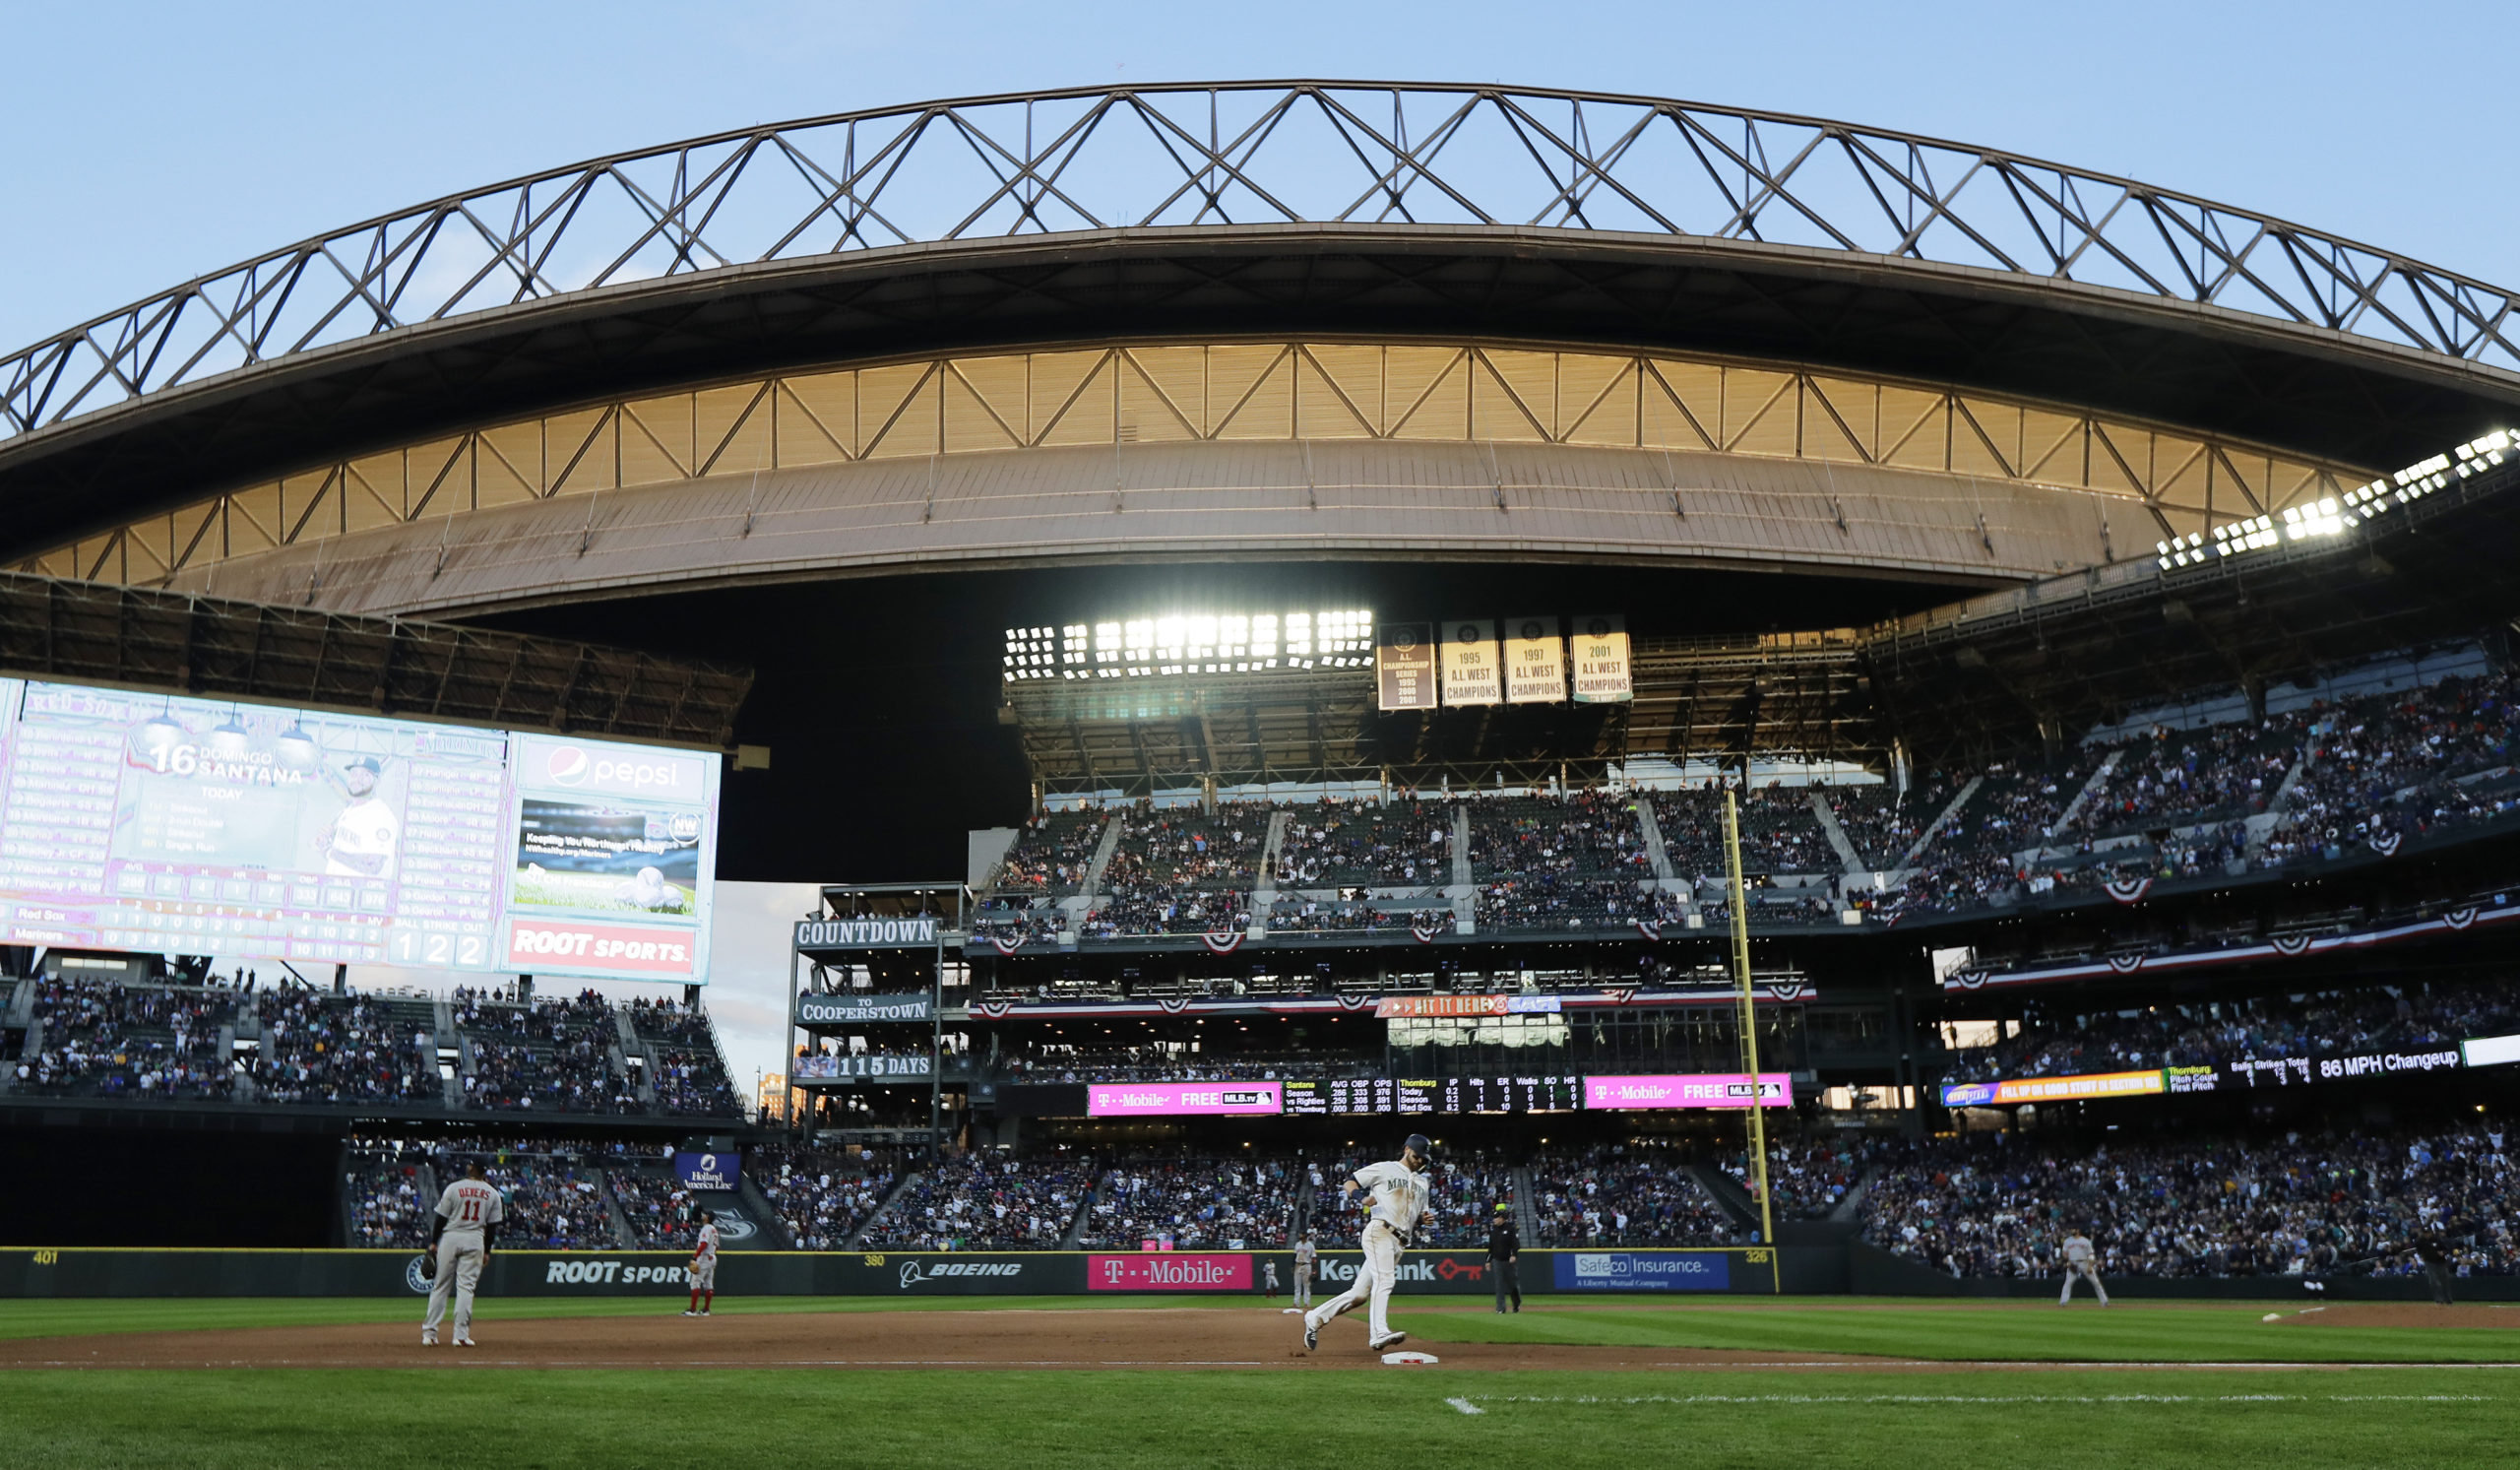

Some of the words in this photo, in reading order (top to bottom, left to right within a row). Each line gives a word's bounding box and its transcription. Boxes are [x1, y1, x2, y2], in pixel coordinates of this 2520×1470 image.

[1459, 652, 1480, 664] 1995
[1524, 649, 1544, 661] 1997
[1590, 646, 1610, 658] 2001
[1383, 661, 1429, 671] CHAMPIONSHIP
[1516, 667, 1531, 678] A.L.
[1532, 665, 1554, 677] WEST
[1583, 663, 1597, 674] A.L.
[1599, 662, 1621, 673] WEST
[1395, 670, 1418, 678] SERIES
[1451, 670, 1466, 681] A.L.
[1468, 668, 1490, 680] WEST
[1447, 685, 1497, 699] CHAMPIONS
[1511, 682, 1561, 696] CHAMPIONS
[1578, 678, 1627, 692] CHAMPIONS
[150, 743, 196, 775] 16
[201, 747, 272, 764] DOMINGO
[199, 761, 302, 784] SANTANA
[595, 760, 677, 789] pepsi
[202, 786, 244, 800] TODAY
[674, 818, 697, 832] NW
[526, 833, 564, 847] Keeping
[564, 836, 583, 847] You
[583, 837, 631, 853] Northwest
[631, 840, 665, 856] Healthy
[525, 844, 612, 860] NWhealthy.org/Mariners
[18, 907, 42, 920] Red
[44, 909, 67, 923] Sox
[324, 927, 337, 938] 10
[368, 917, 383, 927] MV
[394, 917, 419, 930] BALL
[423, 920, 459, 933] STRIKE
[463, 922, 485, 934] OUT
[797, 920, 935, 944] COUNTDOWN
[15, 927, 64, 942] Mariners
[297, 944, 311, 956] 10
[322, 945, 333, 957] 11
[398, 933, 411, 961] 1
[426, 934, 449, 963] 2
[460, 936, 481, 965] 2
[514, 928, 594, 956] ROOT
[594, 938, 687, 963] SPORTS
[857, 998, 873, 1007] TO
[1415, 998, 1435, 1014] HIT
[1439, 997, 1453, 1014] IT
[1457, 996, 1489, 1013] HERE
[802, 1001, 928, 1021] COOPERSTOWN
[887, 1057, 930, 1074] DAYS
[2169, 1065, 2212, 1076] Thornburg
[2231, 1061, 2252, 1072] Balls
[2254, 1059, 2286, 1070] Strikes
[2286, 1056, 2309, 1067] Total
[2319, 1058, 2344, 1078] 86
[2344, 1054, 2384, 1077] MPH
[2384, 1051, 2459, 1071] Changeup
[1351, 1079, 1369, 1088] OBP
[1373, 1079, 1393, 1088] OPS
[1400, 1079, 1437, 1088] Thornburg
[1449, 1078, 1459, 1087] IP
[1469, 1078, 1485, 1087] Hits
[1496, 1077, 1510, 1086] ER
[1516, 1076, 1539, 1086] Walks
[1544, 1076, 1557, 1085] SO
[1563, 1076, 1577, 1085] HR
[2170, 1073, 2192, 1085] Pitch
[2192, 1072, 2219, 1082] Count
[1286, 1089, 1314, 1098] Season
[1400, 1087, 1423, 1097] Today
[1683, 1083, 1724, 1099] FREE
[2001, 1085, 2018, 1099] FILL
[2019, 1084, 2031, 1098] UP
[2032, 1084, 2044, 1097] ON
[2045, 1082, 2069, 1096] GOOD
[2069, 1080, 2098, 1095] STUFF
[2099, 1080, 2108, 1093] IN
[2109, 1078, 2144, 1092] SECTION
[2171, 1082, 2192, 1094] First
[2192, 1081, 2215, 1092] Pitch
[1181, 1092, 1220, 1107] FREE
[1295, 1097, 1326, 1107] Righties
[1445, 1095, 1459, 1104] 0.2
[1294, 1106, 1327, 1115] Thornburg
[1352, 1104, 1369, 1113] .000
[1374, 1104, 1392, 1113] .000
[1400, 1104, 1417, 1113] Red
[1446, 1103, 1460, 1112] 6.2
[1500, 1102, 1511, 1111] 10
[692, 1171, 724, 1182] Holland
[684, 1179, 714, 1189] America
[715, 1180, 733, 1189] Line
[459, 1186, 491, 1201] DEVERS
[461, 1199, 480, 1222] 11
[32, 1250, 58, 1265] 401
[864, 1254, 885, 1267] 380
[1745, 1251, 1769, 1264] 326
[546, 1260, 621, 1284] ROOT
[622, 1266, 692, 1284] SPORT
[928, 1263, 1023, 1276] BOEING
[1579, 1257, 1627, 1274] Safeco
[1633, 1257, 1702, 1273] Insurance
[1583, 1279, 1607, 1289] Liberty
[1634, 1280, 1670, 1289] Company
